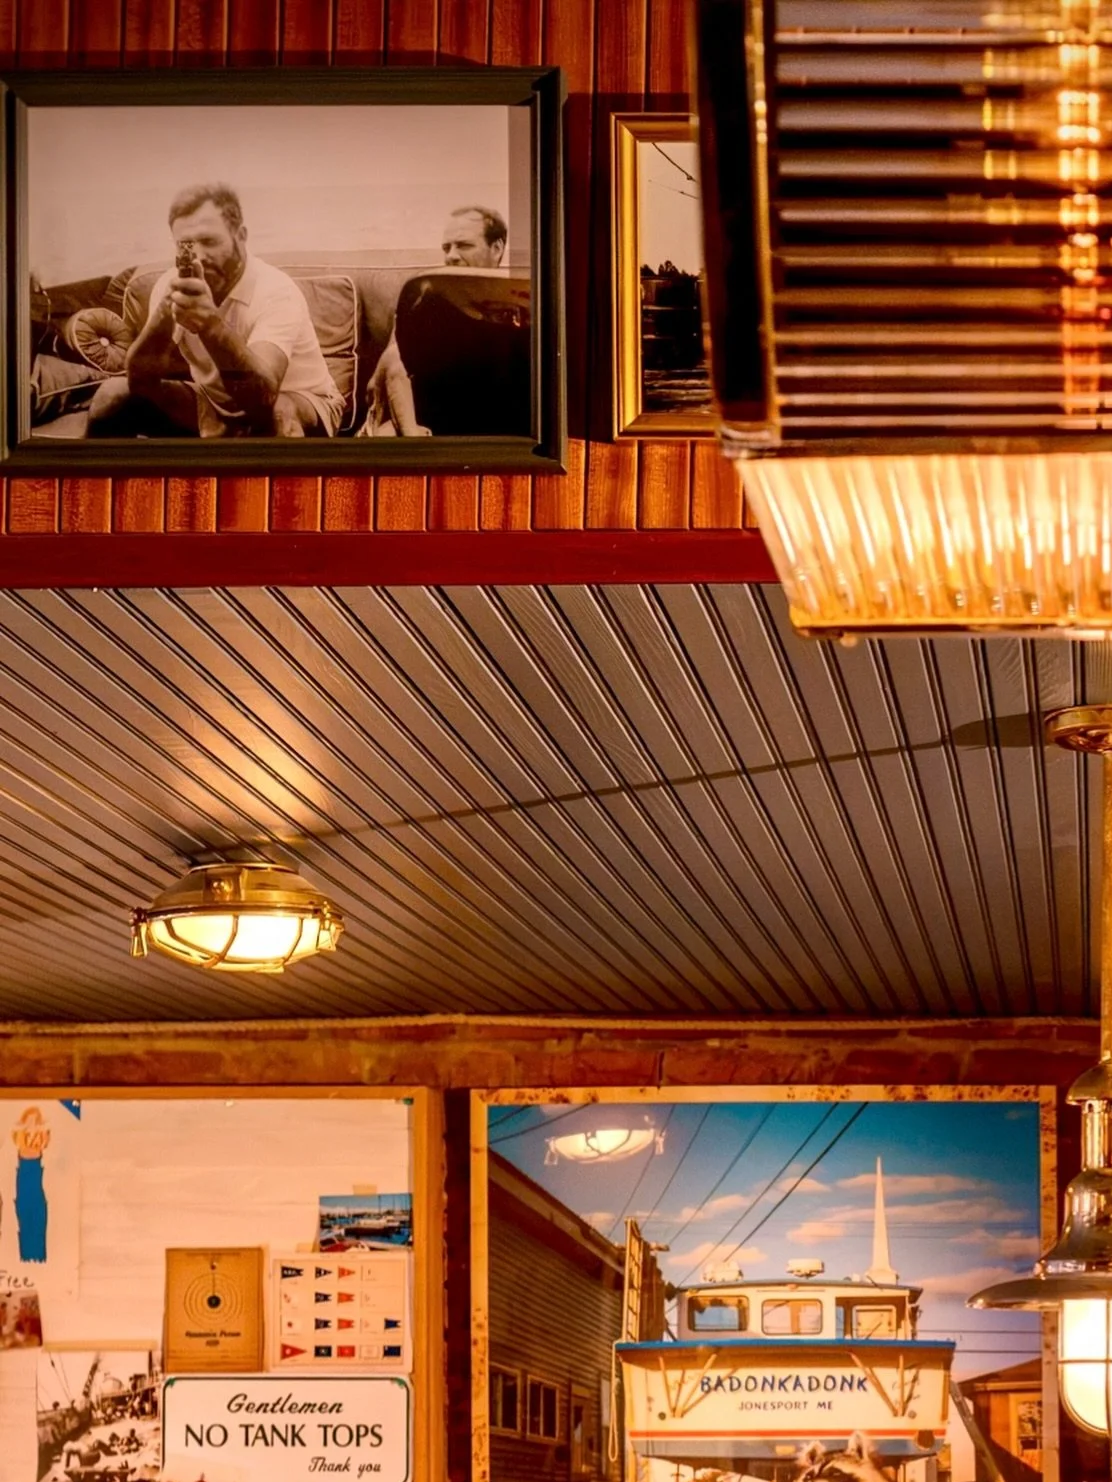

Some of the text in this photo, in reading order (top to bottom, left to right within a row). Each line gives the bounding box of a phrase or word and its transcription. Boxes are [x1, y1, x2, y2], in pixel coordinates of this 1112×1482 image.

[700, 1374, 868, 1393] BADONKADONK
[226, 1392, 344, 1414] Gentlemen
[738, 1400, 833, 1410] JONESPORT ME
[184, 1423, 384, 1448] NO TANK TOPS
[308, 1456, 382, 1479] Thank you
